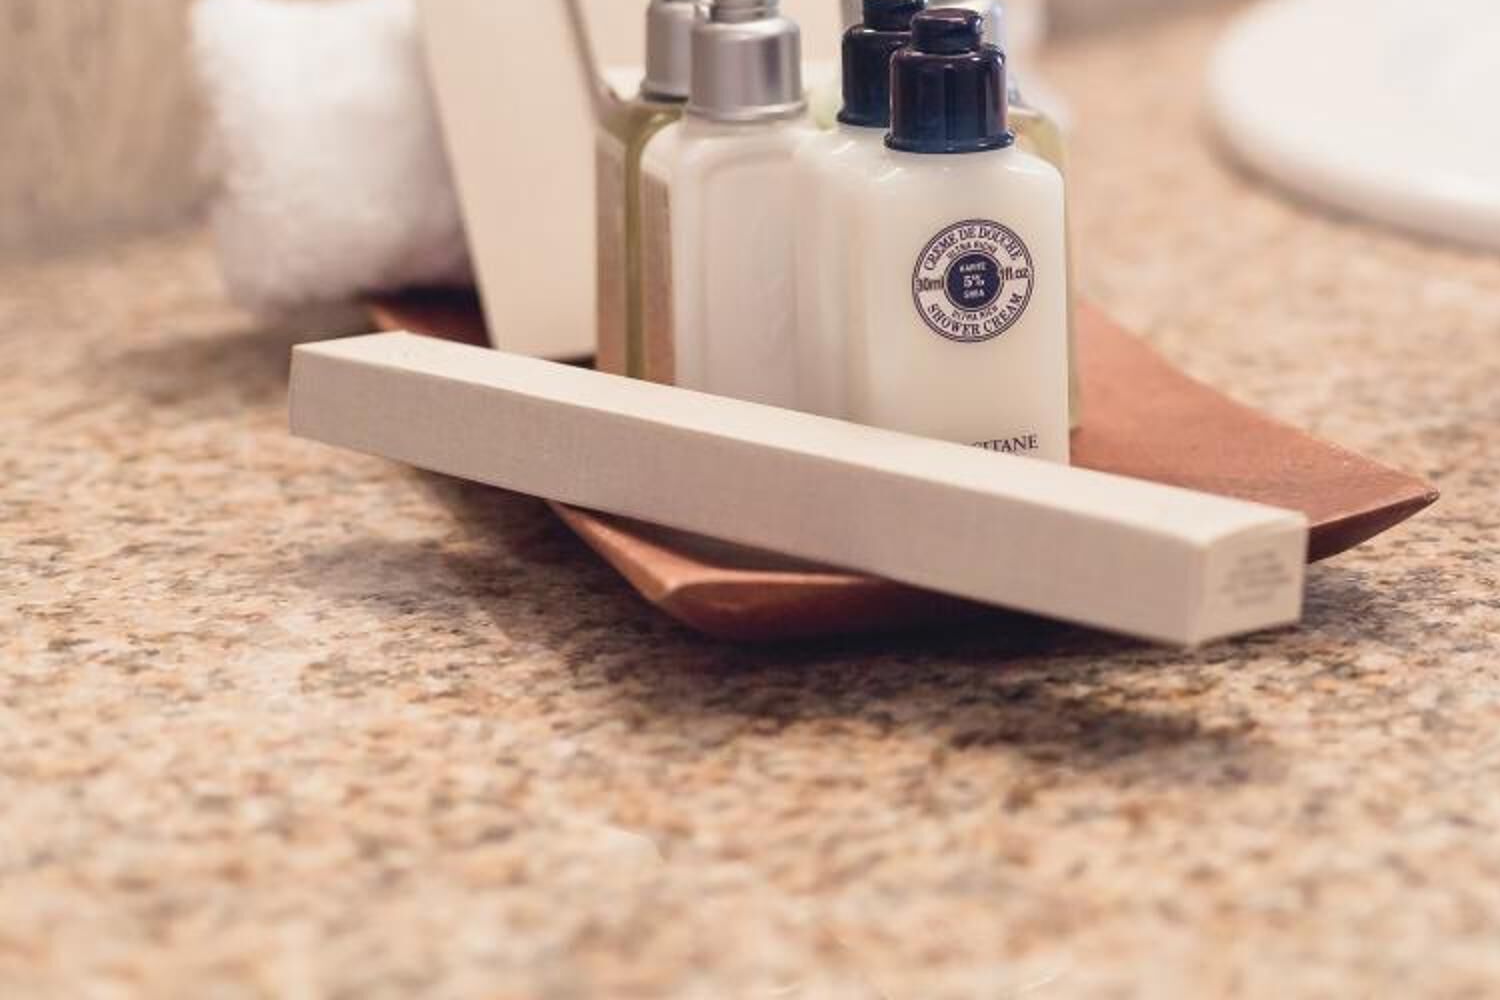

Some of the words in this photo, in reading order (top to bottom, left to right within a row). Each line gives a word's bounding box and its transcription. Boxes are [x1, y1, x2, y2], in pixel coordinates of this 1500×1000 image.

[959, 226, 977, 241] DE
[978, 226, 1023, 261] DOUCHE
[963, 274, 985, 289] 5%
[927, 303, 980, 335] SHOWER
[983, 292, 1023, 329] CREAM
